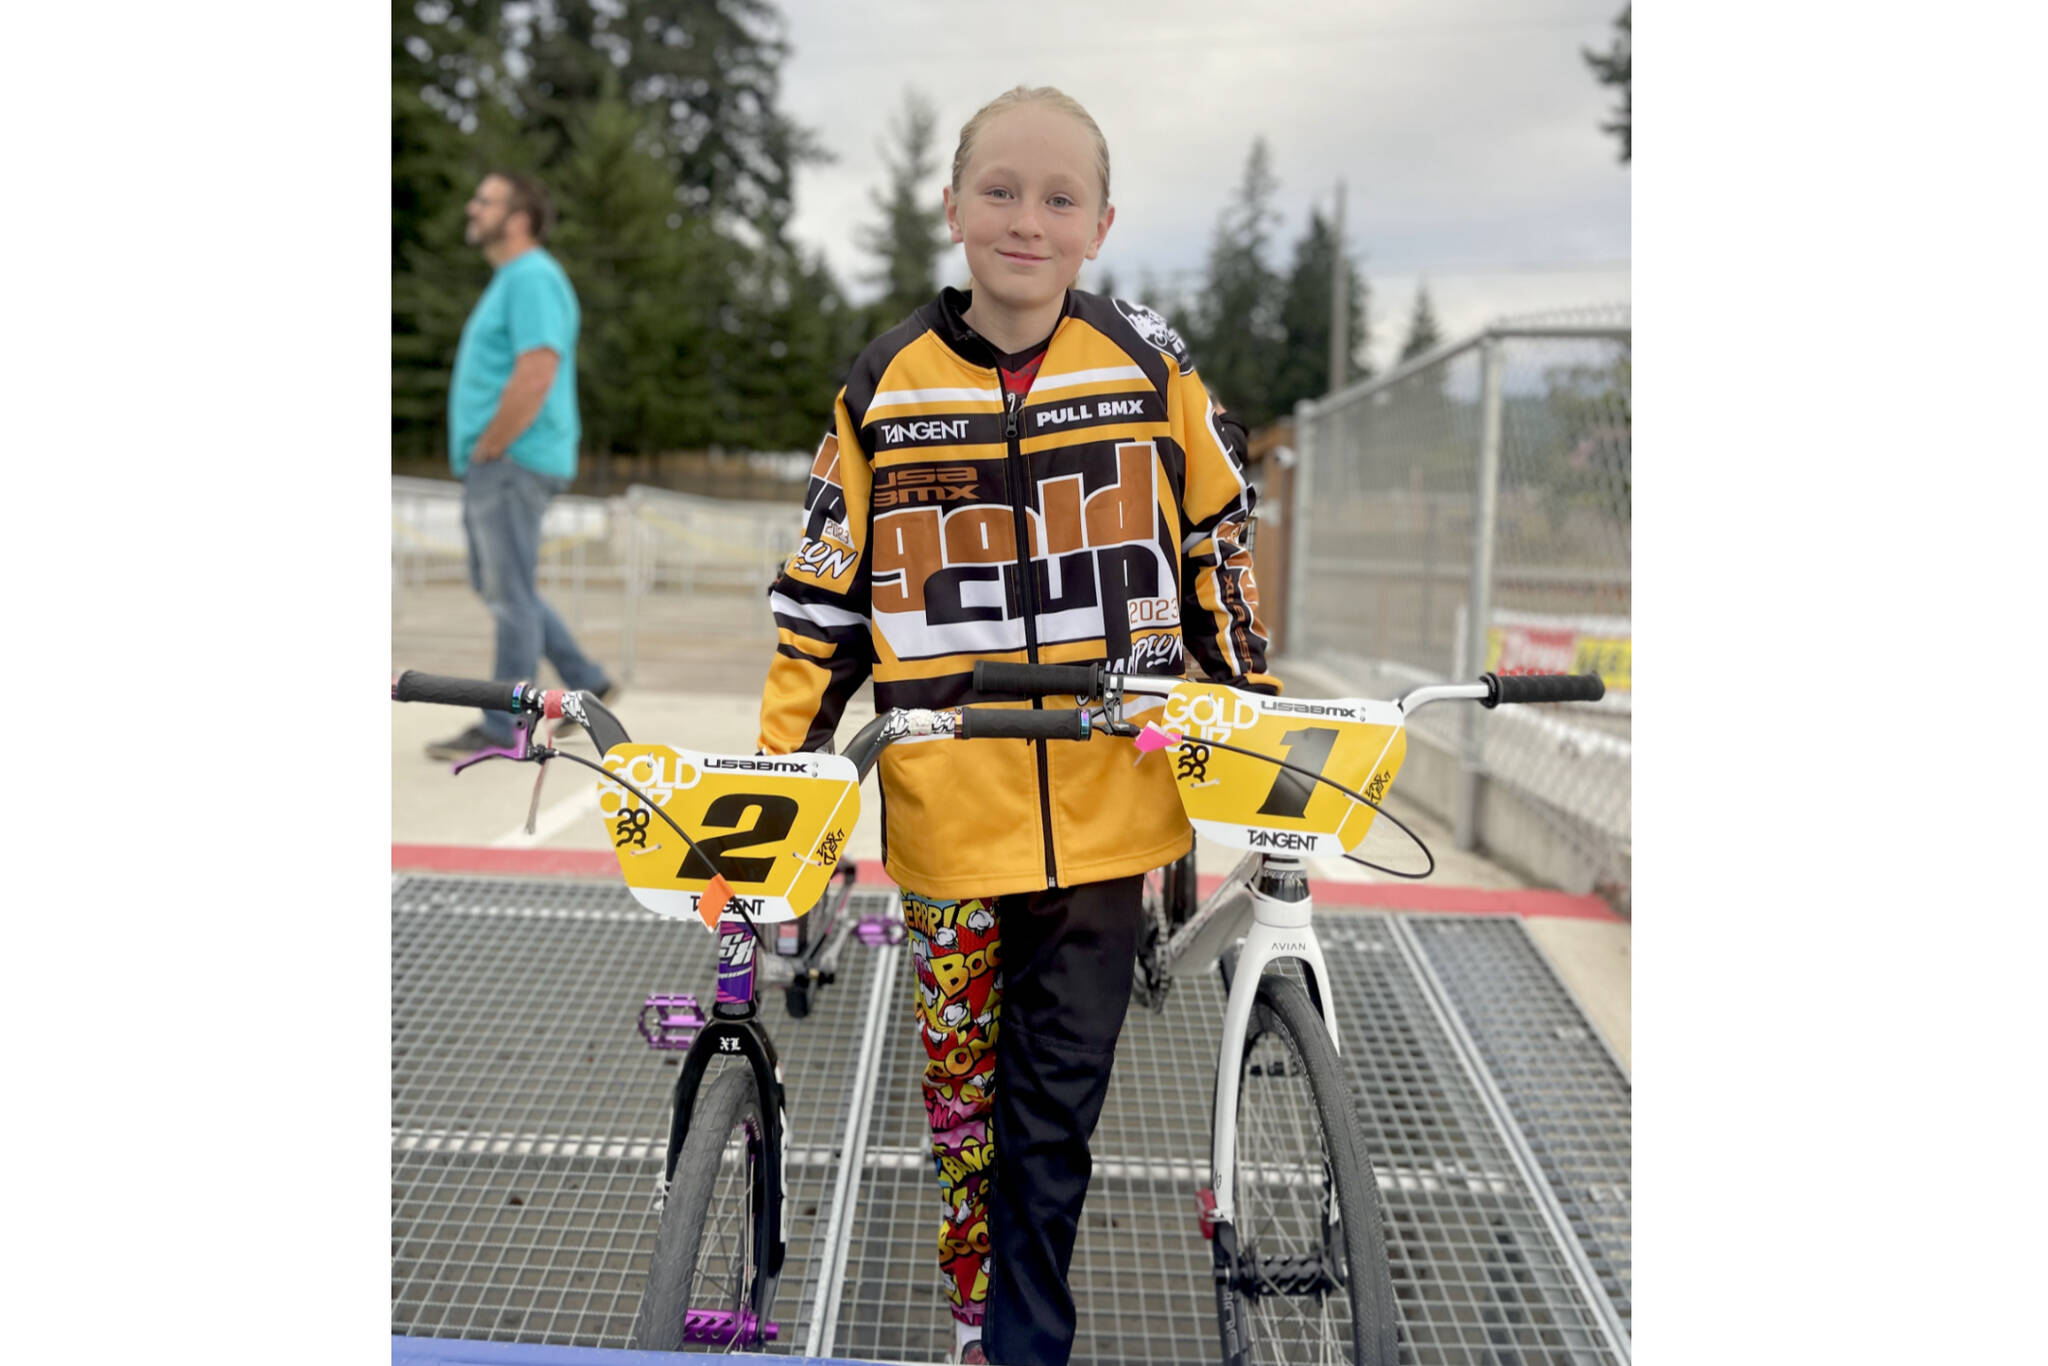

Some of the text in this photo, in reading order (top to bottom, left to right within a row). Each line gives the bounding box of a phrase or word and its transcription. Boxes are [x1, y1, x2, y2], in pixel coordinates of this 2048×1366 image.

[1036, 399, 1145, 428] PULL BMX
[881, 420, 969, 444] TANGENT
[825, 518, 849, 545] 2023
[872, 441, 1158, 614] gold
[923, 544, 1159, 658] cup
[1128, 597, 1179, 625] 2023
[1162, 691, 1261, 730] GOLD
[600, 753, 704, 790] GOLD
[1256, 725, 1341, 820] 1
[675, 792, 800, 884] 2
[1247, 828, 1319, 852] TANGENT
[690, 895, 765, 916] TGENT
[1271, 942, 1306, 952] AVIAN
